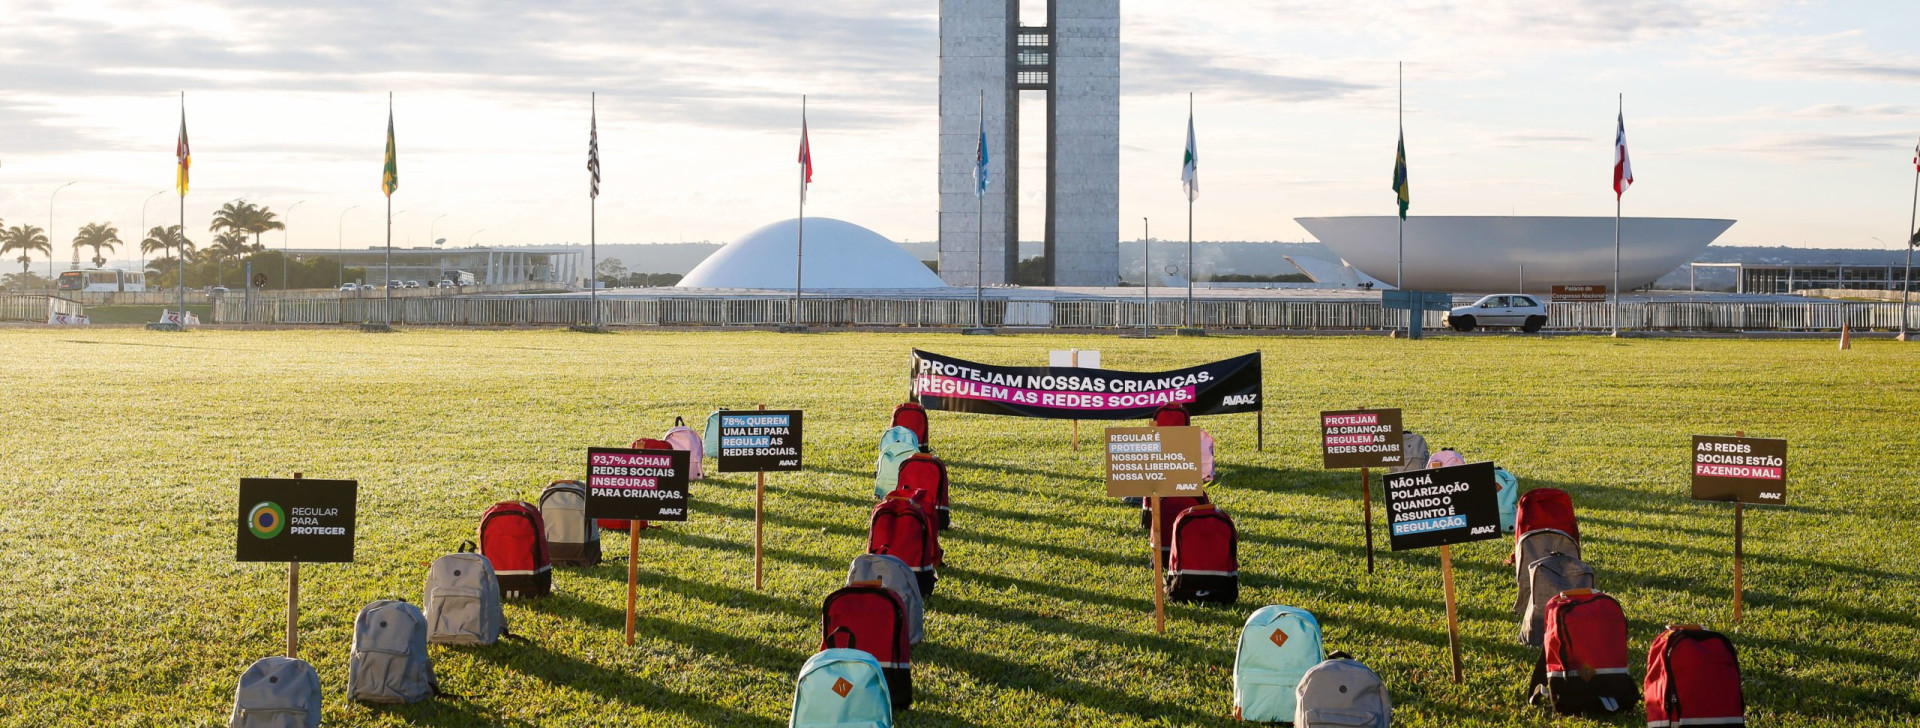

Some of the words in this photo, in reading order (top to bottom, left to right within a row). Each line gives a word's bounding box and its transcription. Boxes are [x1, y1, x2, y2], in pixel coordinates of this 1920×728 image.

[920, 359, 1022, 388] PROTEJAM
[1027, 375, 1106, 392] NOSSAS
[1110, 371, 1214, 393] CRIANÇAS.
[918, 377, 1008, 400] REGULEM
[1012, 392, 1038, 404] AS
[1042, 393, 1104, 408] REDES
[1108, 389, 1192, 407] SOCIAIS.
[1222, 394, 1257, 406] AVAAZ
[723, 417, 745, 426] 78%
[746, 417, 787, 427] QUEREM
[1325, 416, 1376, 424] PROTEJAM
[723, 428, 746, 436] UMA
[1340, 425, 1392, 434] CRIANÇAS!
[723, 438, 768, 446] REGULAR
[1111, 434, 1152, 442] REGULAR
[1155, 432, 1160, 441] É
[1327, 435, 1371, 444] REGULEM
[723, 448, 754, 456] REDES
[756, 448, 797, 456] SOCIAIS.
[1111, 444, 1159, 452] PROTEGER
[1328, 446, 1357, 454] REDES
[1359, 444, 1400, 452] SOCIAIS!
[1697, 442, 1712, 451] AS
[1714, 443, 1751, 453] REDES
[593, 456, 626, 466] 93,7%
[628, 457, 670, 466] ACHAM
[1151, 453, 1186, 461] FILHOS,
[1697, 454, 1744, 465] SOCIAIS
[1746, 456, 1783, 466] ESTÃO
[592, 466, 628, 476] REDES
[630, 468, 675, 477] SOCIAIS
[1112, 463, 1143, 471] NOSSA
[1145, 462, 1197, 471] LIBERDADE,
[1697, 465, 1750, 476] FAZENDO
[1752, 468, 1780, 478] MAL.
[592, 477, 655, 487] INSEGURAS
[1390, 477, 1414, 489] NÃO
[1416, 474, 1432, 486] HÁ
[591, 488, 621, 497] PARA
[623, 489, 683, 500] CRIANÇAS.
[1391, 482, 1469, 500] POLARIZAÇÃO
[1392, 498, 1440, 512] QUANDO
[1442, 496, 1451, 505] O
[292, 507, 338, 516] REGULAR
[1394, 508, 1446, 522] ASSUNTO
[1448, 505, 1455, 515] É
[292, 517, 318, 525] PARA
[1396, 517, 1465, 534] REGULAÇÃO.
[291, 527, 345, 535] PROTEGER
[1470, 525, 1496, 535] AVAAZ
